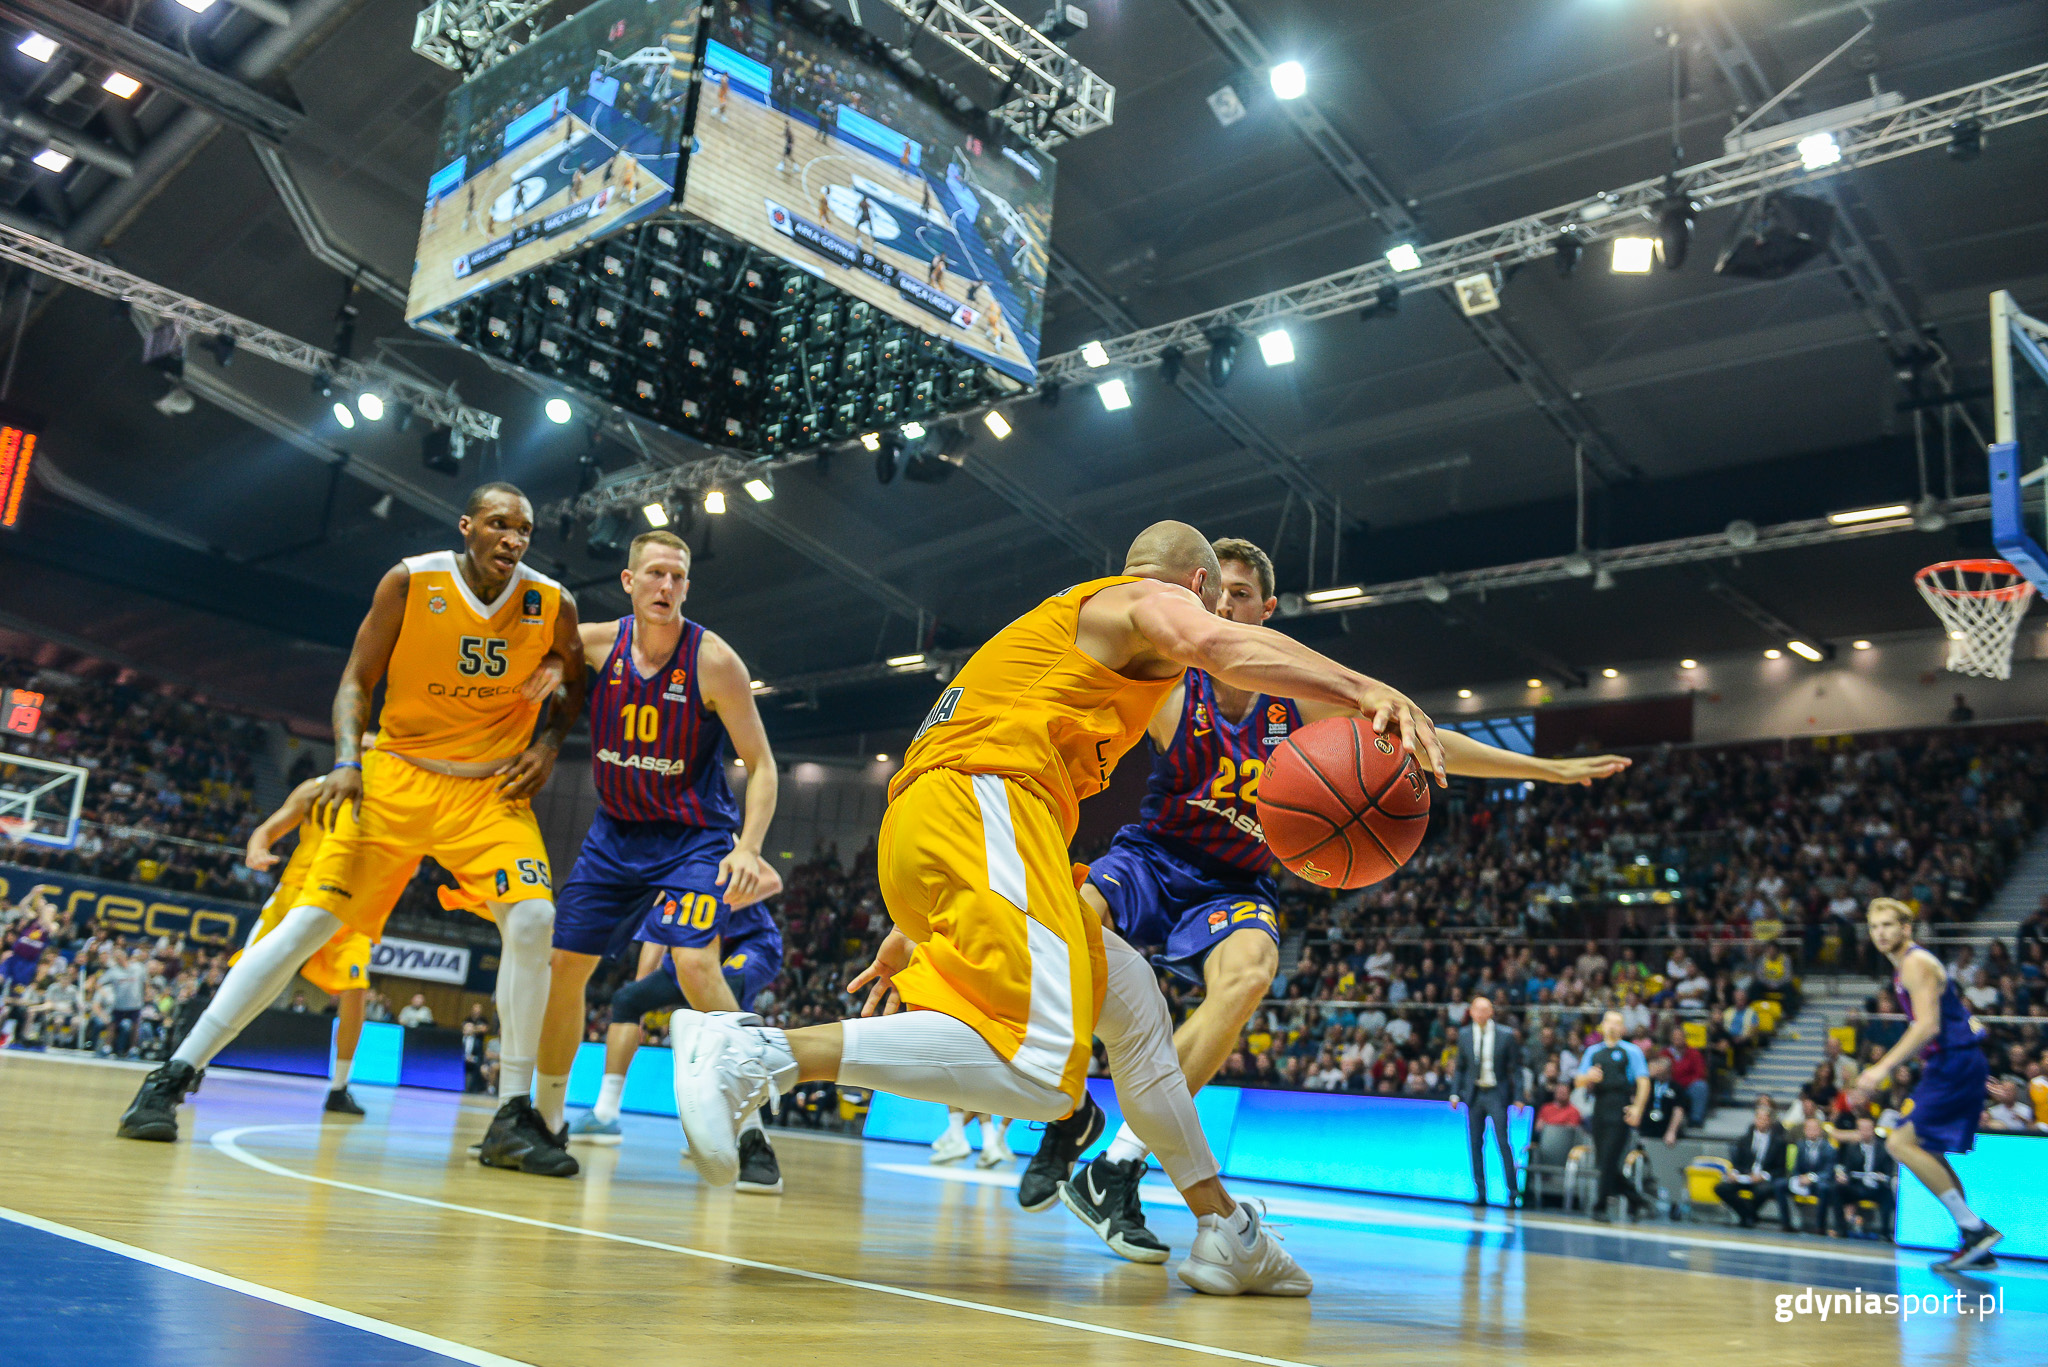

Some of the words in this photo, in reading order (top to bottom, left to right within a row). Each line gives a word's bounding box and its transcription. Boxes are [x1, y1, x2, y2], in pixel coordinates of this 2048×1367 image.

[457, 635, 509, 678] 55
[621, 703, 659, 743] 10
[609, 751, 685, 776] LASSA
[1211, 756, 1266, 804] 22
[677, 892, 717, 930] 10
[1230, 901, 1277, 933] 22
[371, 944, 460, 972] DYNIA
